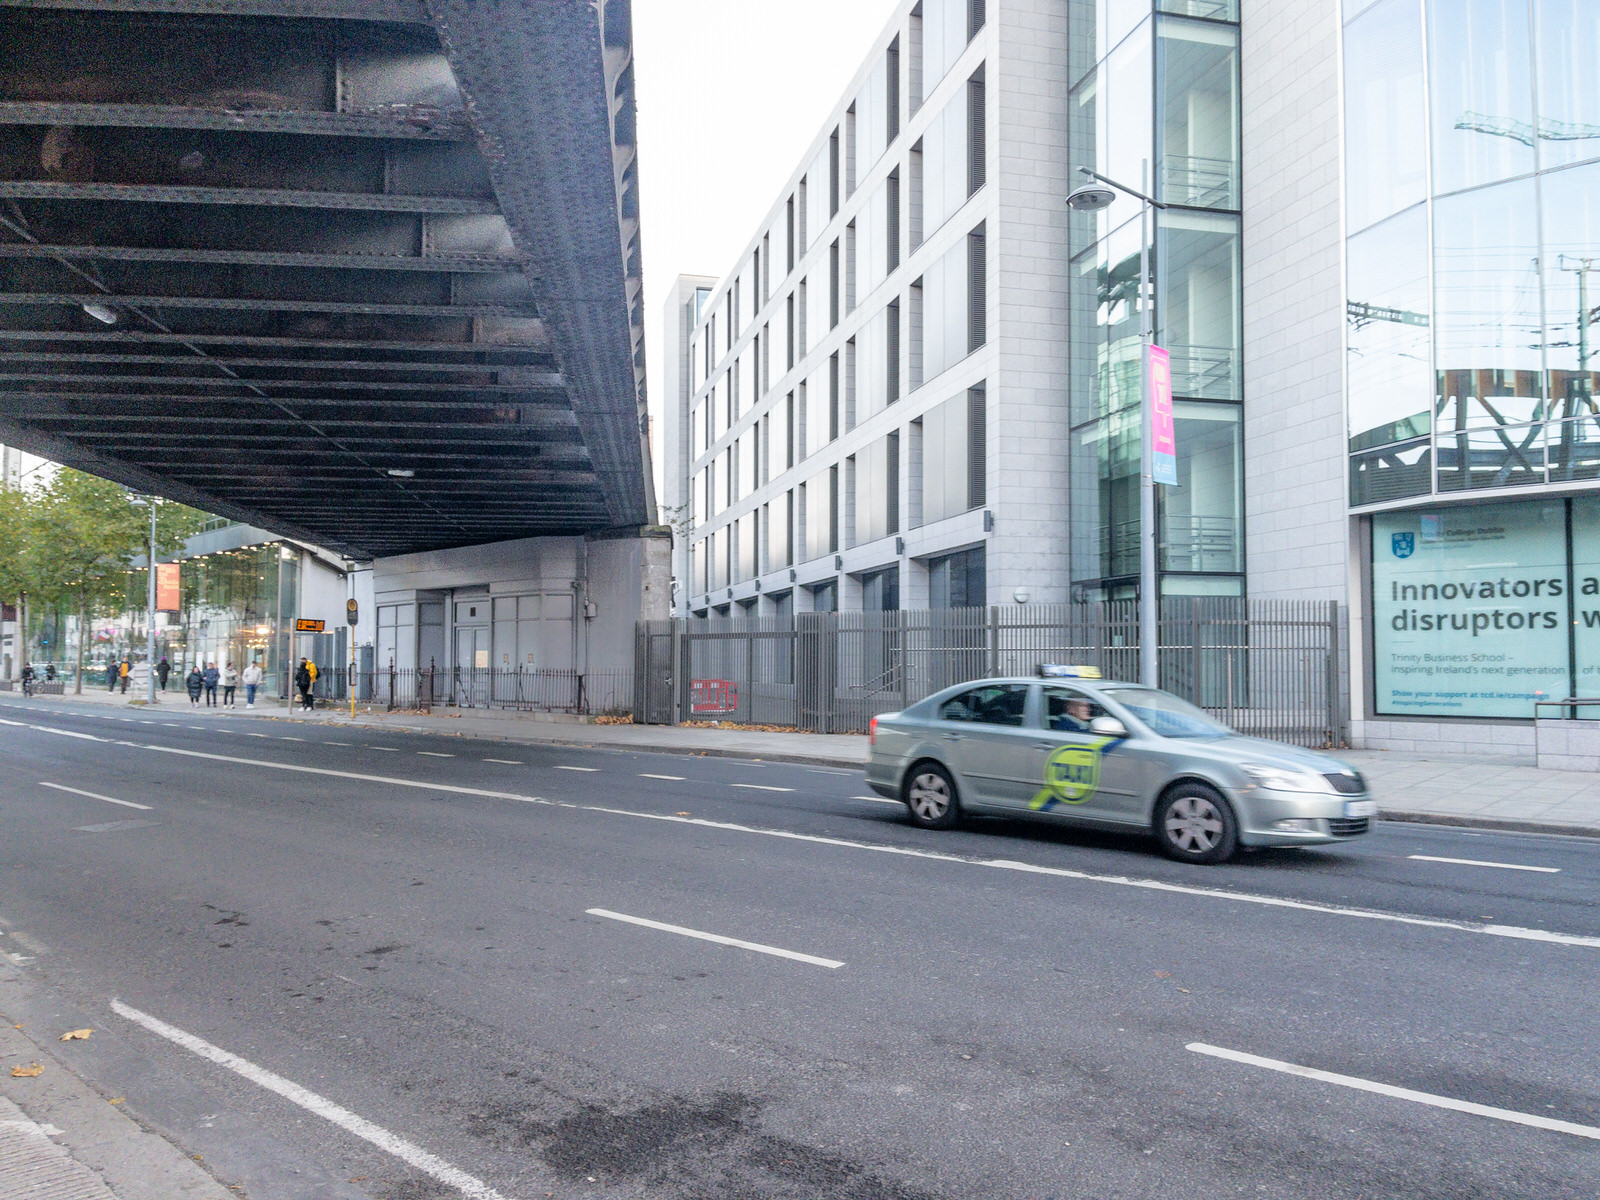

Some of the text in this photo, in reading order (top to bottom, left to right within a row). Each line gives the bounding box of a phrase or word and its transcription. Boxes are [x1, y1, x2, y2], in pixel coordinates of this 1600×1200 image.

[1392, 577, 1563, 601] Innovators
[1391, 609, 1558, 637] disruptors
[1391, 653, 1421, 664] Trinity
[1424, 653, 1469, 662] Business
[1471, 653, 1505, 662] School
[1436, 665, 1479, 674] Ireland's
[1481, 666, 1505, 674] next
[1507, 666, 1566, 676] generation
[1582, 665, 1594, 674] of
[1391, 689, 1413, 697] Show
